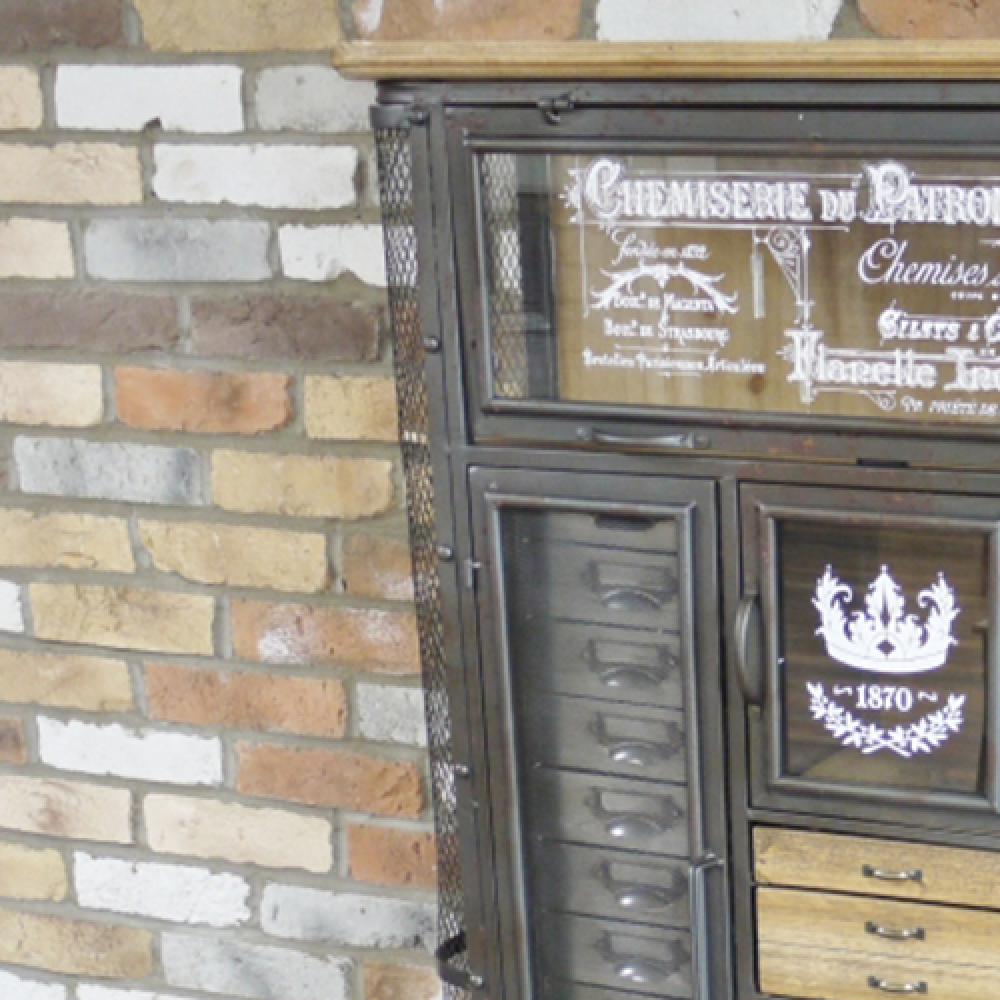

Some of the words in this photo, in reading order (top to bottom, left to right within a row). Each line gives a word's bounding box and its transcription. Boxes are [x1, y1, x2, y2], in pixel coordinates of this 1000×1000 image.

[817, 188, 857, 223] DU
[858, 237, 988, 287] Chemises
[856, 684, 912, 712] 1870
